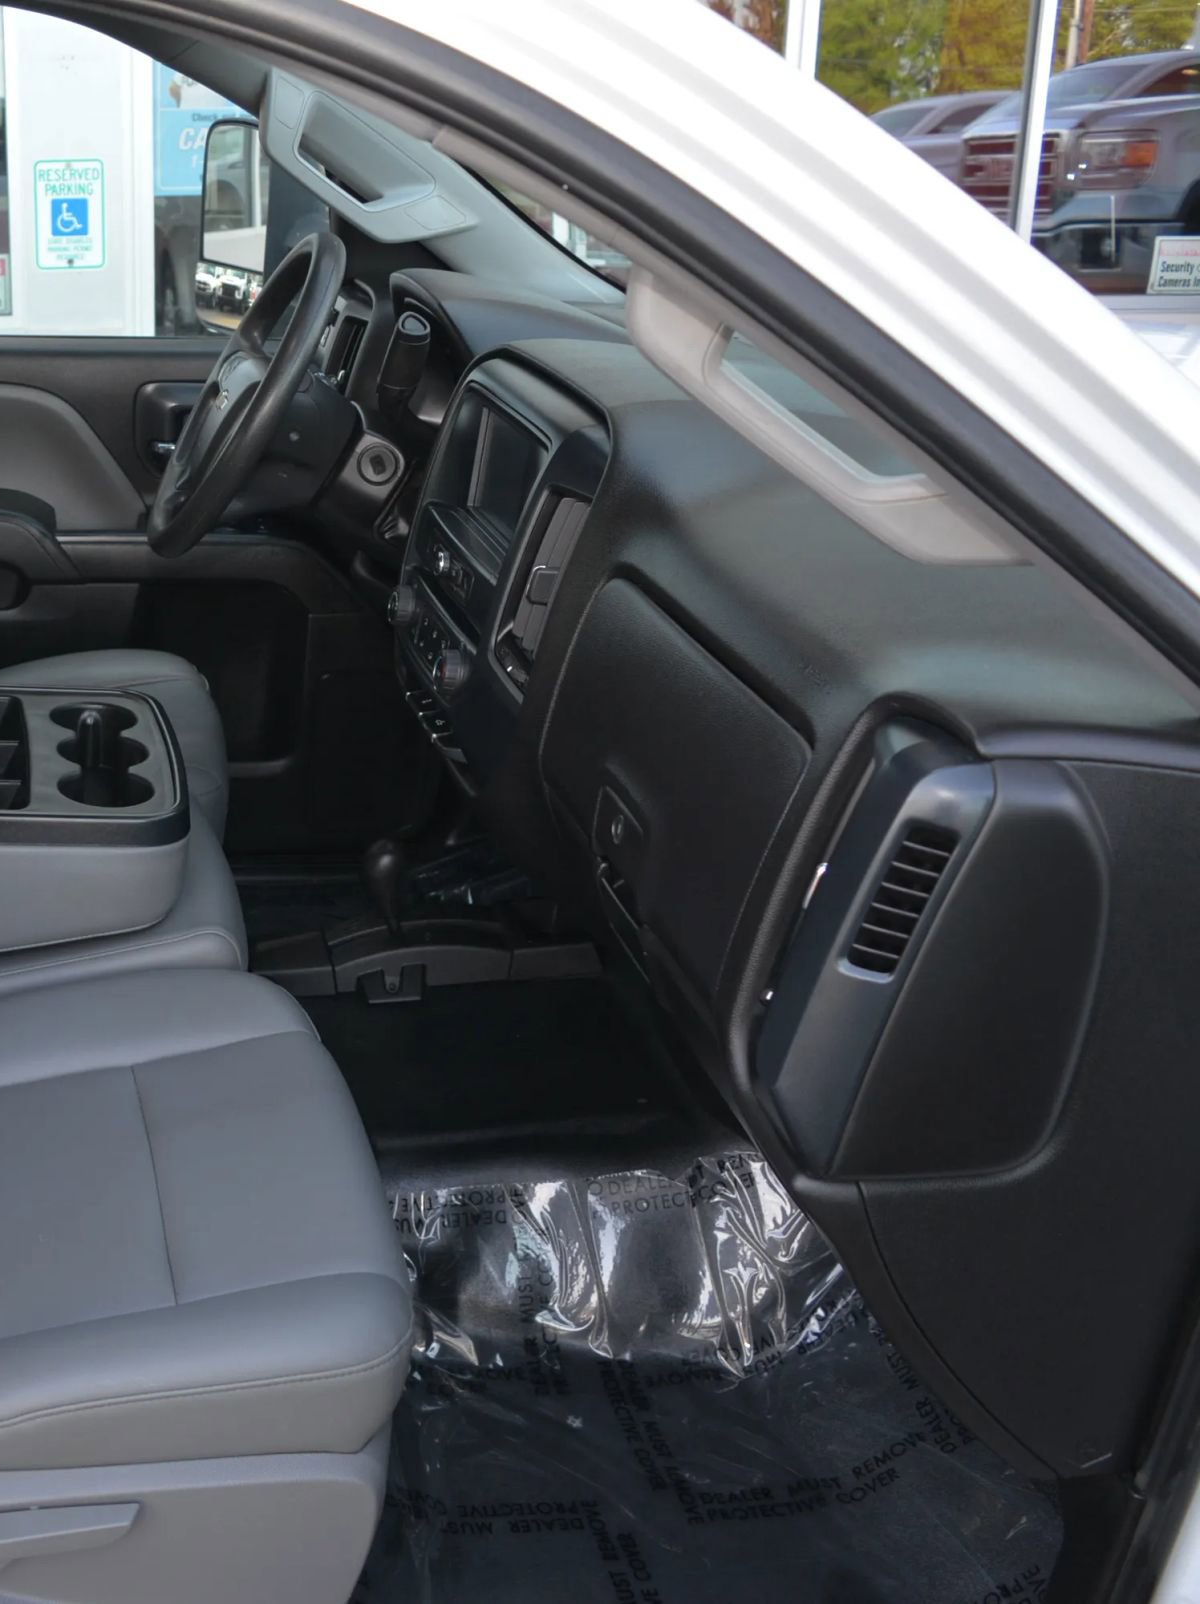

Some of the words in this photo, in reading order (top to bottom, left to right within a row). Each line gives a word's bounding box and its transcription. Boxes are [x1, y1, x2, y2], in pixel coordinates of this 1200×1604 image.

[38, 168, 100, 182] RESERVED
[45, 183, 94, 196] PARKING
[1161, 261, 1195, 276] Security
[1158, 276, 1192, 288] Cameras
[915, 1396, 958, 1455] DEALER
[701, 1486, 774, 1505] DEALER
[787, 1476, 843, 1499] MUST
[834, 1468, 901, 1505] COVER
[456, 1502, 585, 1519] PROTECTIVE
[509, 1519, 585, 1534] DEALER
